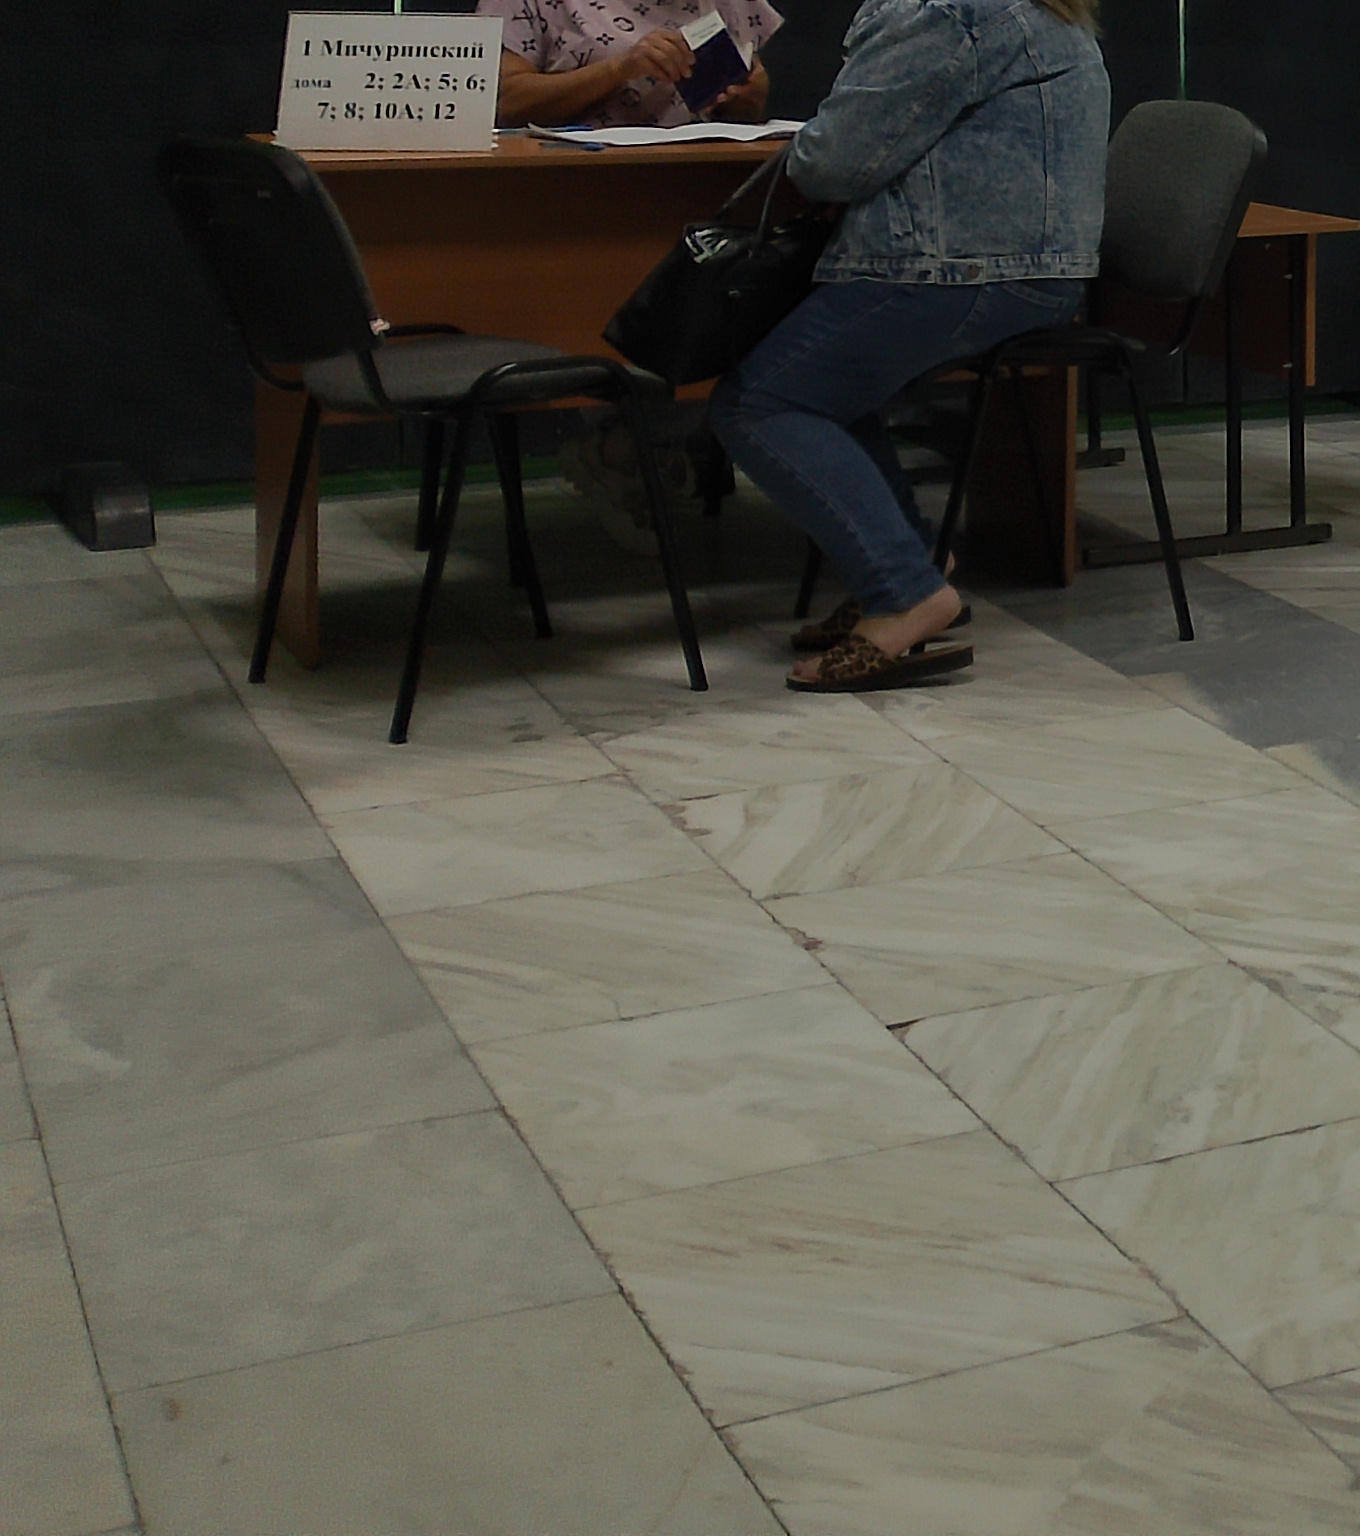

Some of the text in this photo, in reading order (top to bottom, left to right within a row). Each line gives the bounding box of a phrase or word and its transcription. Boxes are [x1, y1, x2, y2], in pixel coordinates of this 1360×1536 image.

[302, 39, 484, 61] 1 Мичуринский
[292, 72, 486, 92] дома 2; 2А; 5; 6;
[317, 102, 456, 122] 7; 8; 10А; 12
